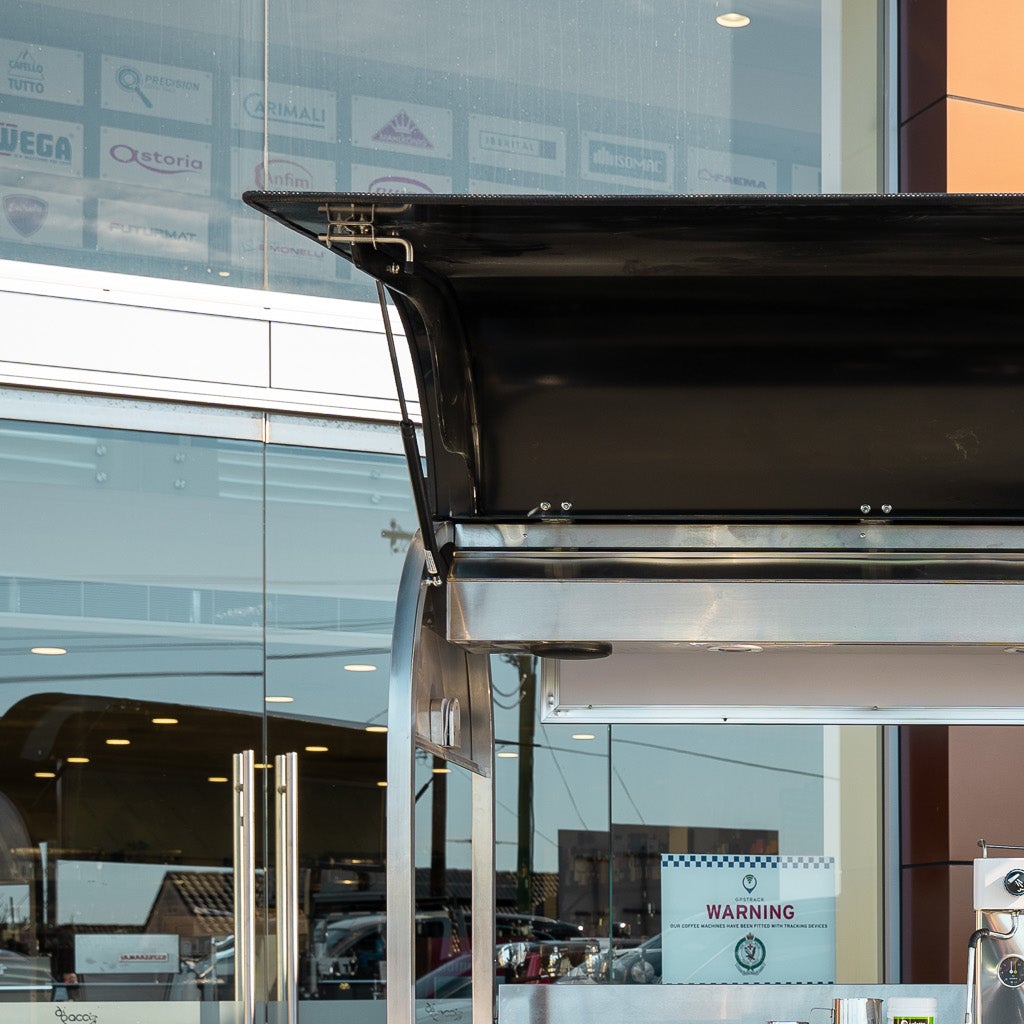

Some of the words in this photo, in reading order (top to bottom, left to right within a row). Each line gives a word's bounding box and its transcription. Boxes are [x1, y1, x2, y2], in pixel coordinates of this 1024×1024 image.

[8, 77, 45, 94] TUTTO
[145, 74, 200, 91] PRECISION
[259, 244, 325, 258] SMONELLI
[706, 904, 795, 920] WARNING
